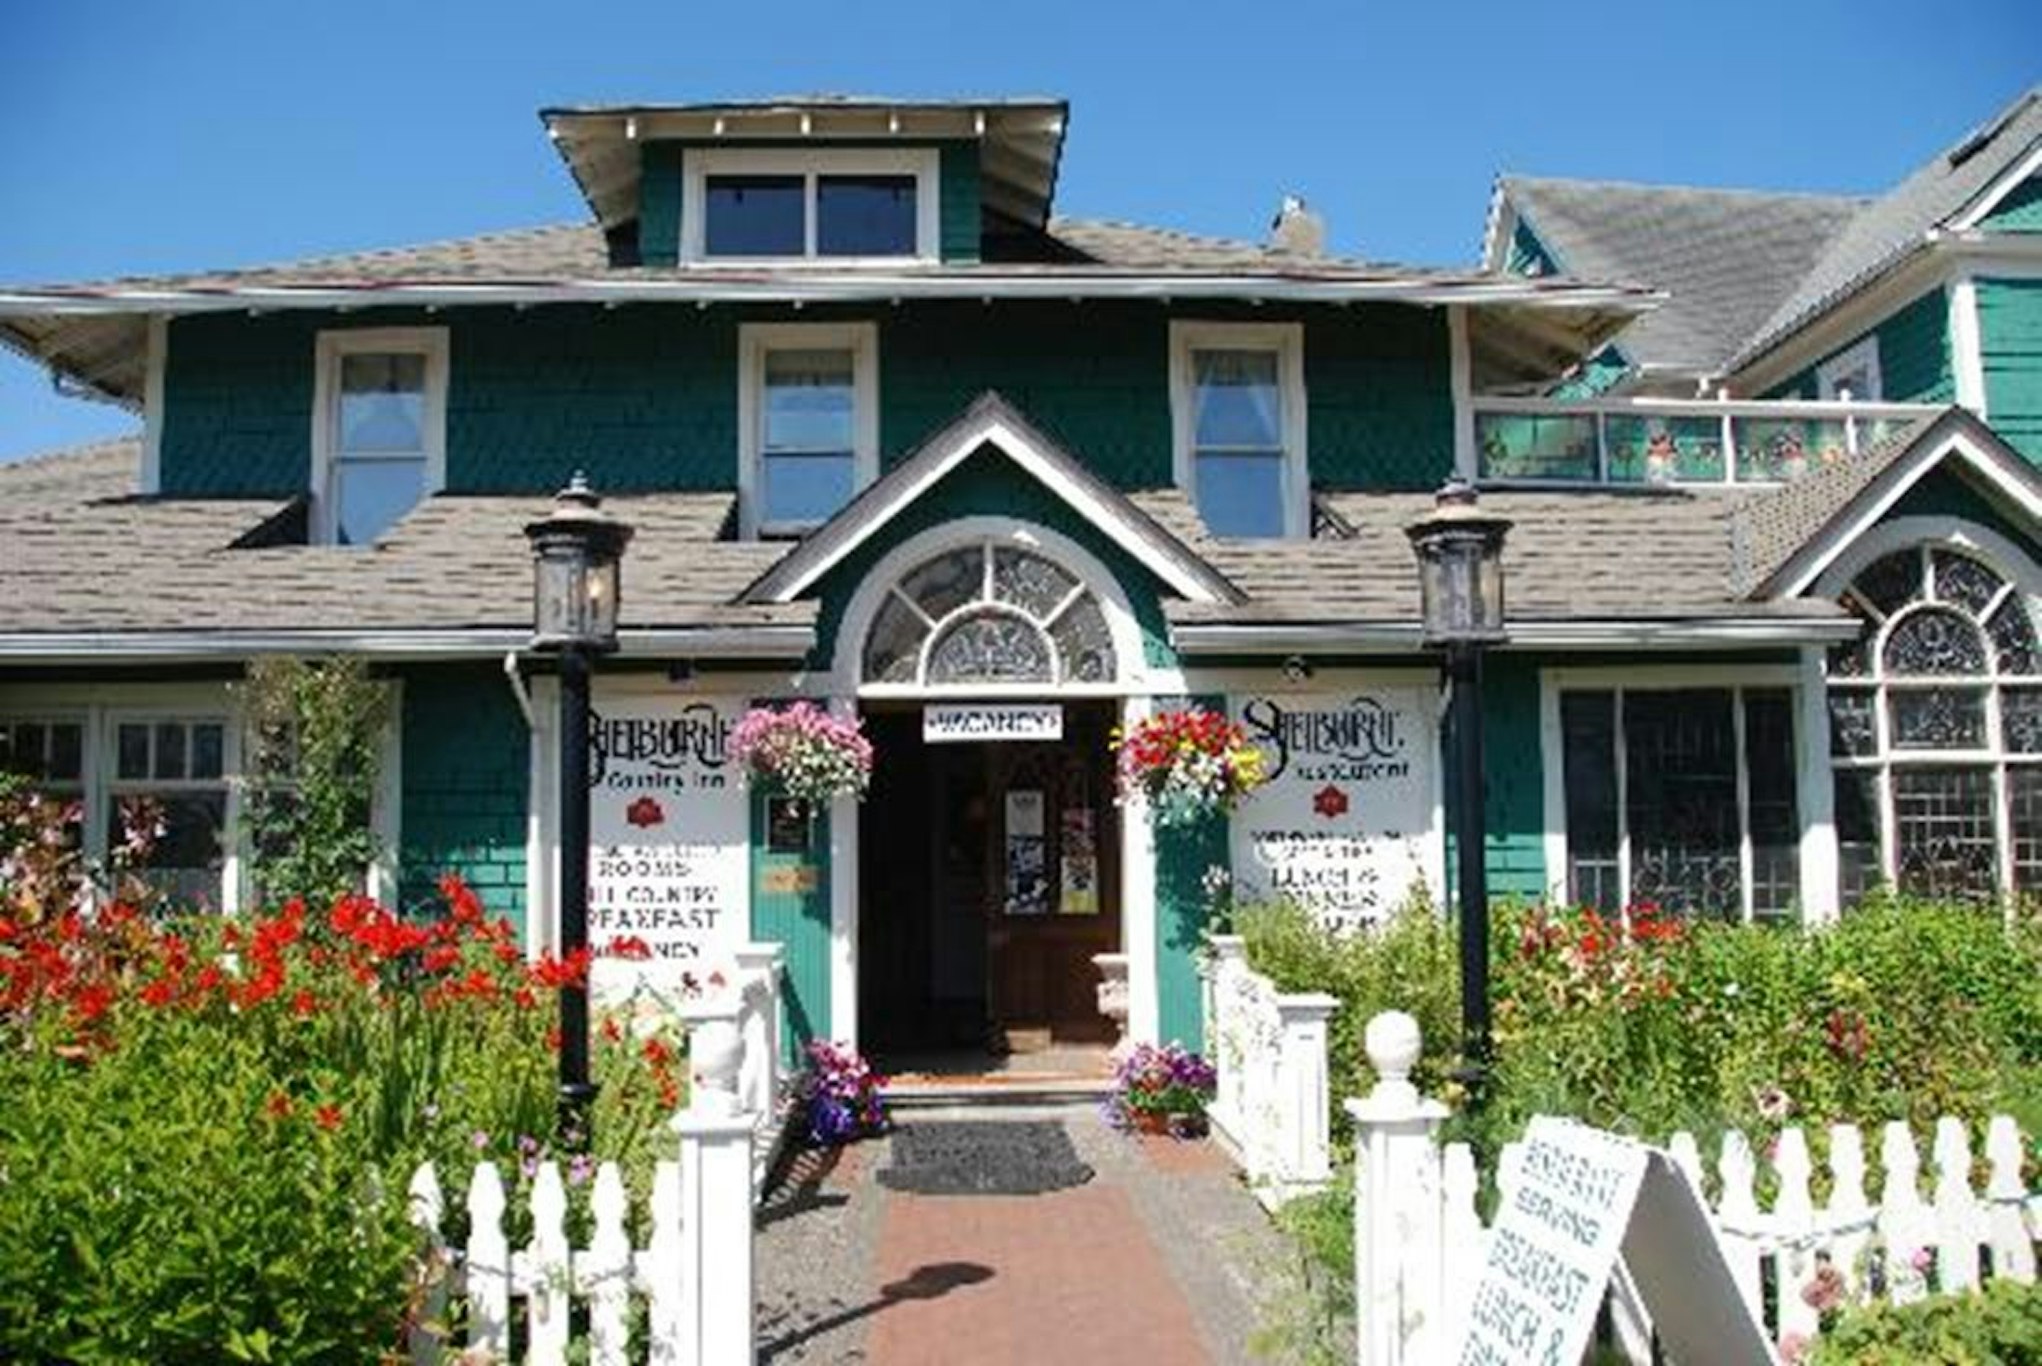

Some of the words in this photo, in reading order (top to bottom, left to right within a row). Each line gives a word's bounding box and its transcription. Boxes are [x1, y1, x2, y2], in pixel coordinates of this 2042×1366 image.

[937, 711, 1048, 733] VACANCY
[608, 771, 684, 796] Country
[599, 860, 692, 877] ROOMS
[588, 909, 721, 929] REAKFAST
